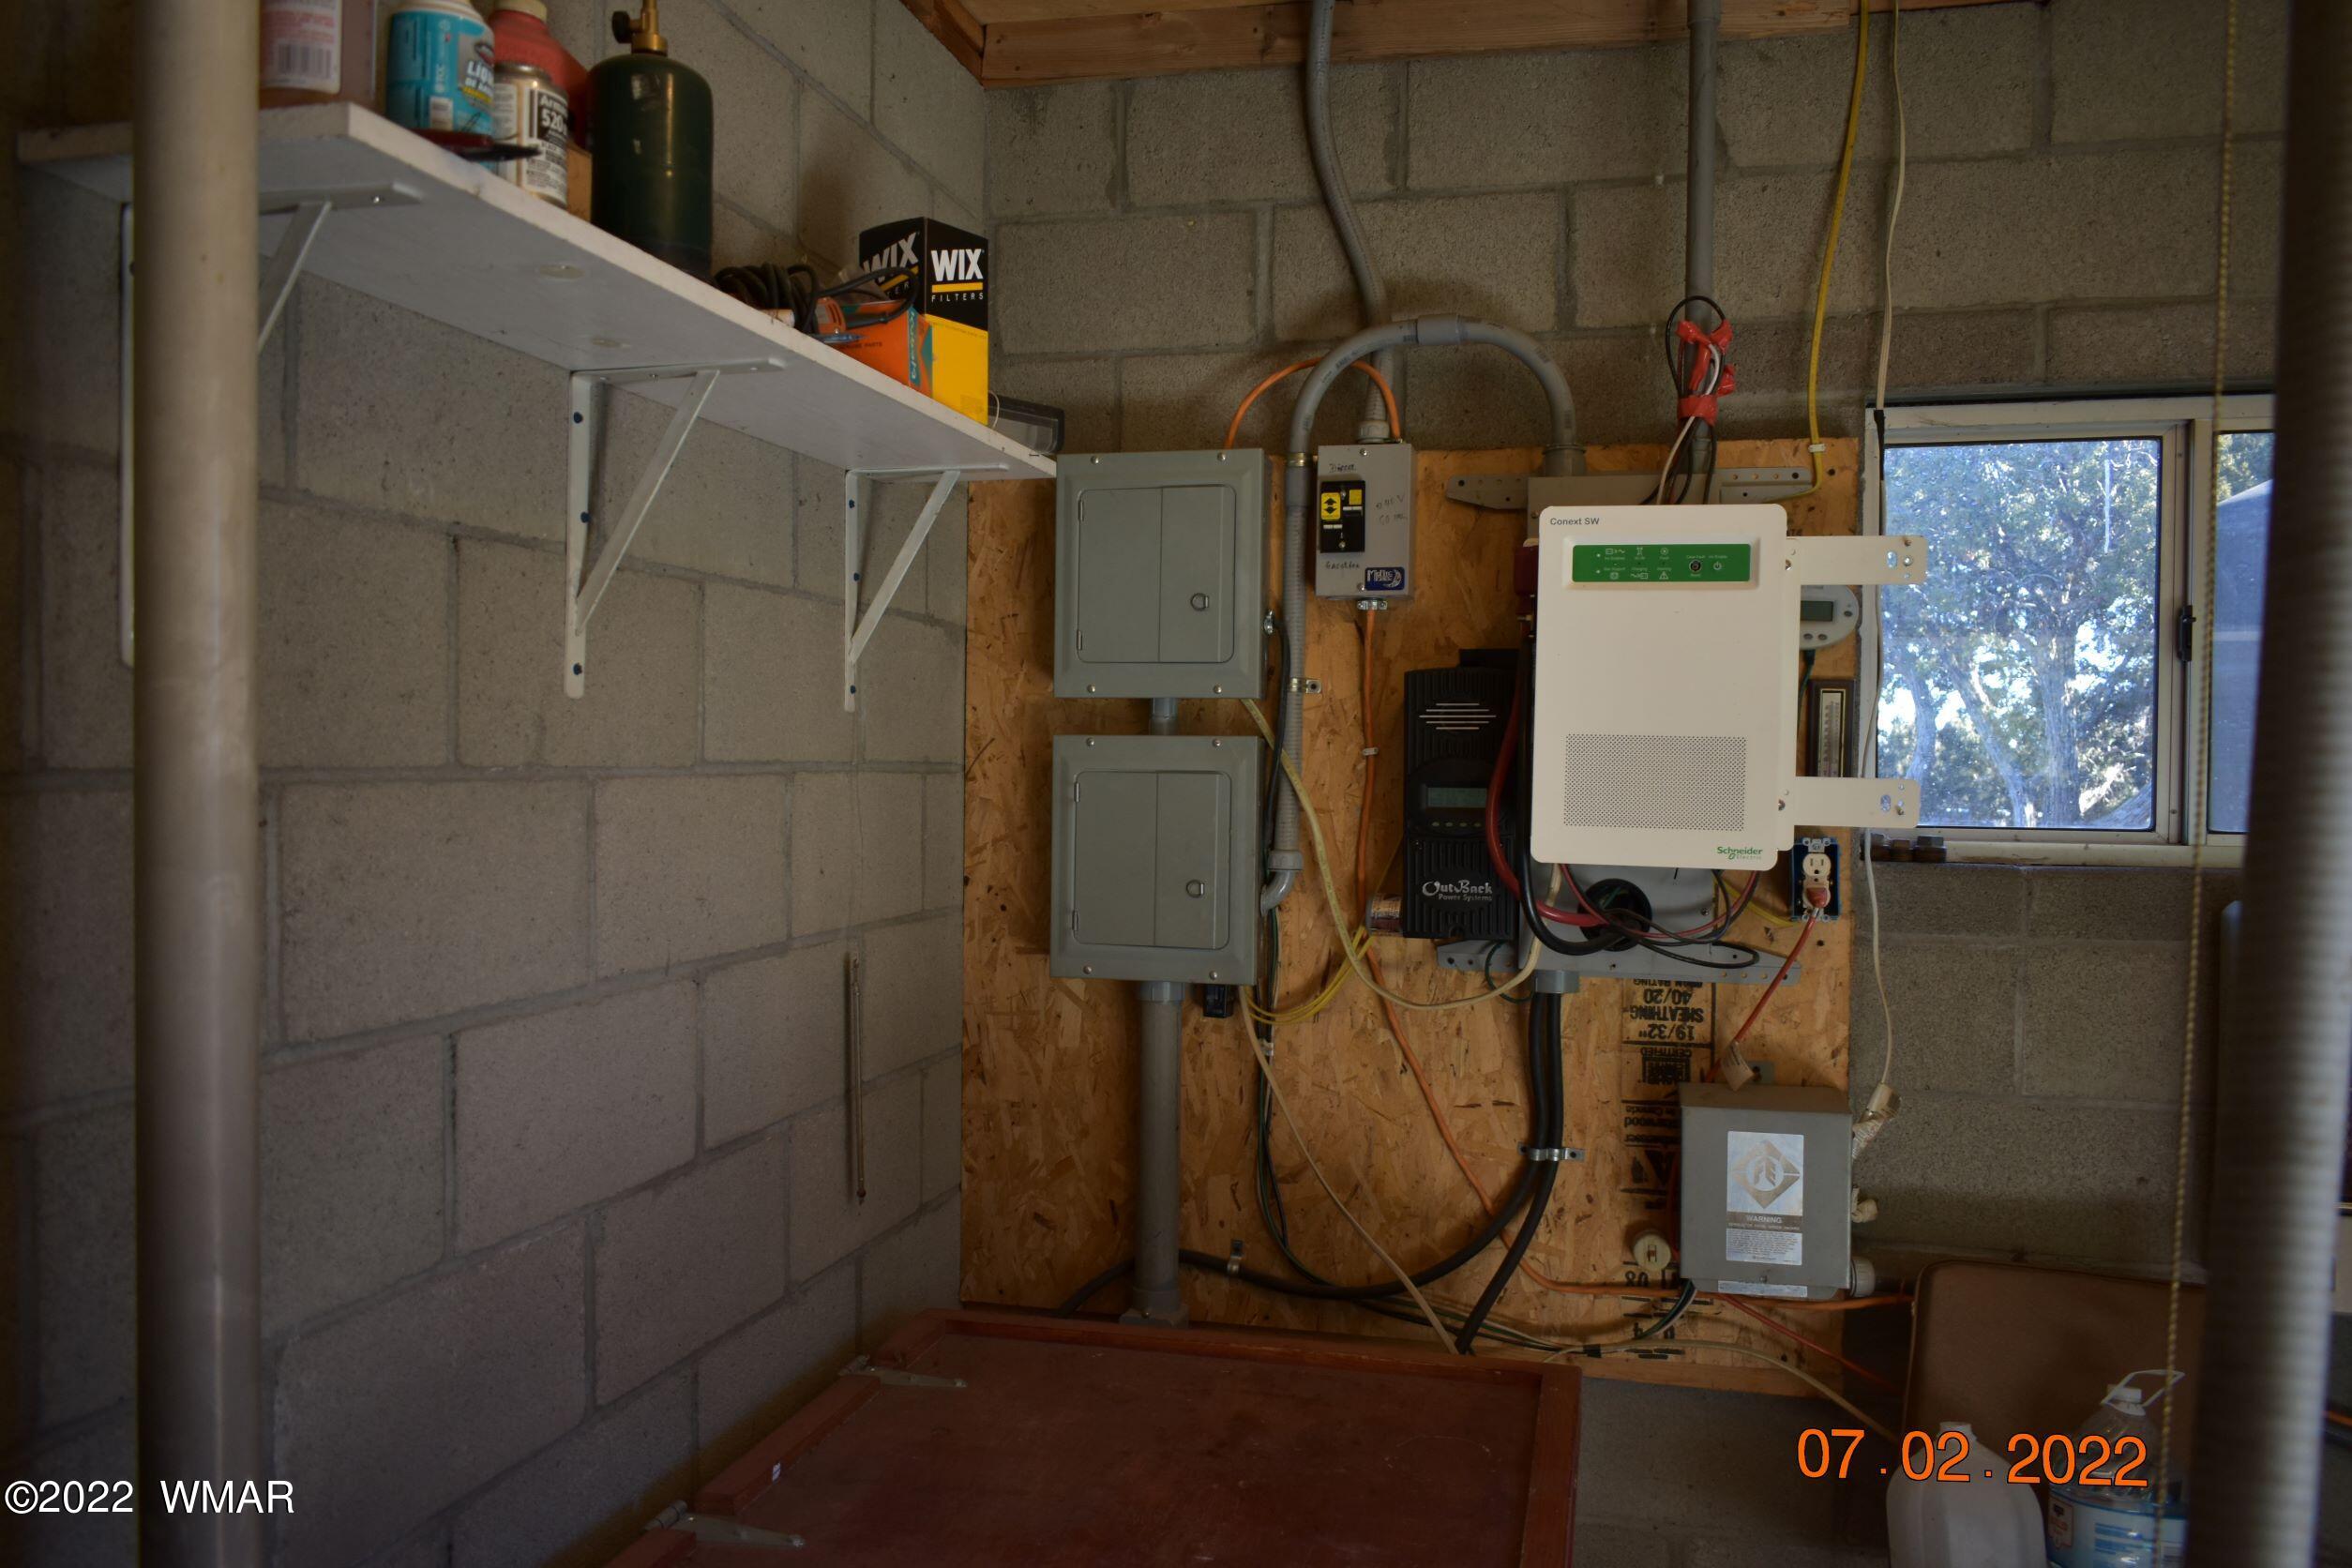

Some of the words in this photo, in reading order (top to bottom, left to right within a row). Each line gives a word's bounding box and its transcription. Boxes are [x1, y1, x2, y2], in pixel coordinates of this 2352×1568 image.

[863, 233, 918, 283] WIX
[931, 249, 983, 281] WIX
[931, 292, 984, 303] FILTERS
[1550, 518, 1582, 526] Conext
[1584, 518, 1600, 526] SW
[1717, 846, 1763, 855] Schneider
[1422, 880, 1493, 897] OutBack
[1643, 988, 1693, 1005] 40/20
[1629, 1005, 1704, 1023] SHEATHING
[1746, 1215, 1783, 1224] WARNING
